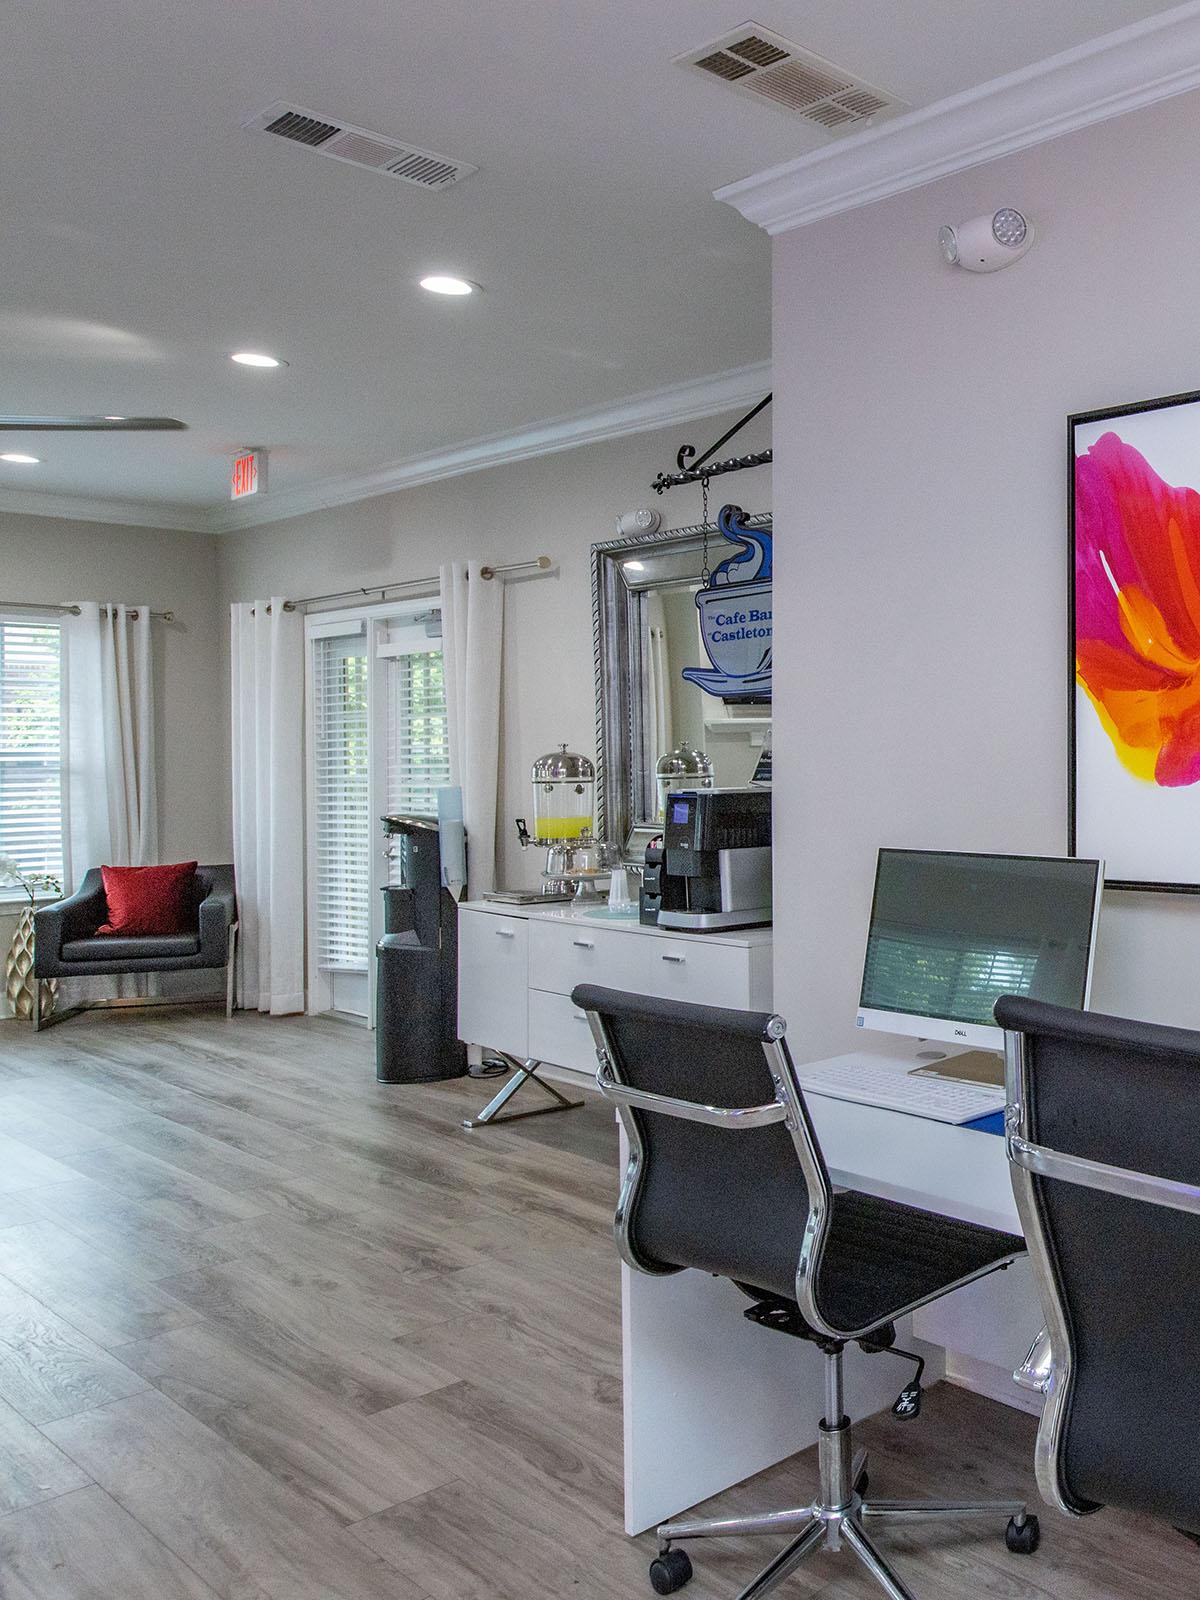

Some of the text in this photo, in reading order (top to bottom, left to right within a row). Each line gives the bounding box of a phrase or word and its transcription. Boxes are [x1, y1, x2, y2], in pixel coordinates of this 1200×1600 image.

[235, 455, 254, 496] EXIT
[716, 611, 746, 626] Cafe
[954, 1029, 967, 1037] DELL
